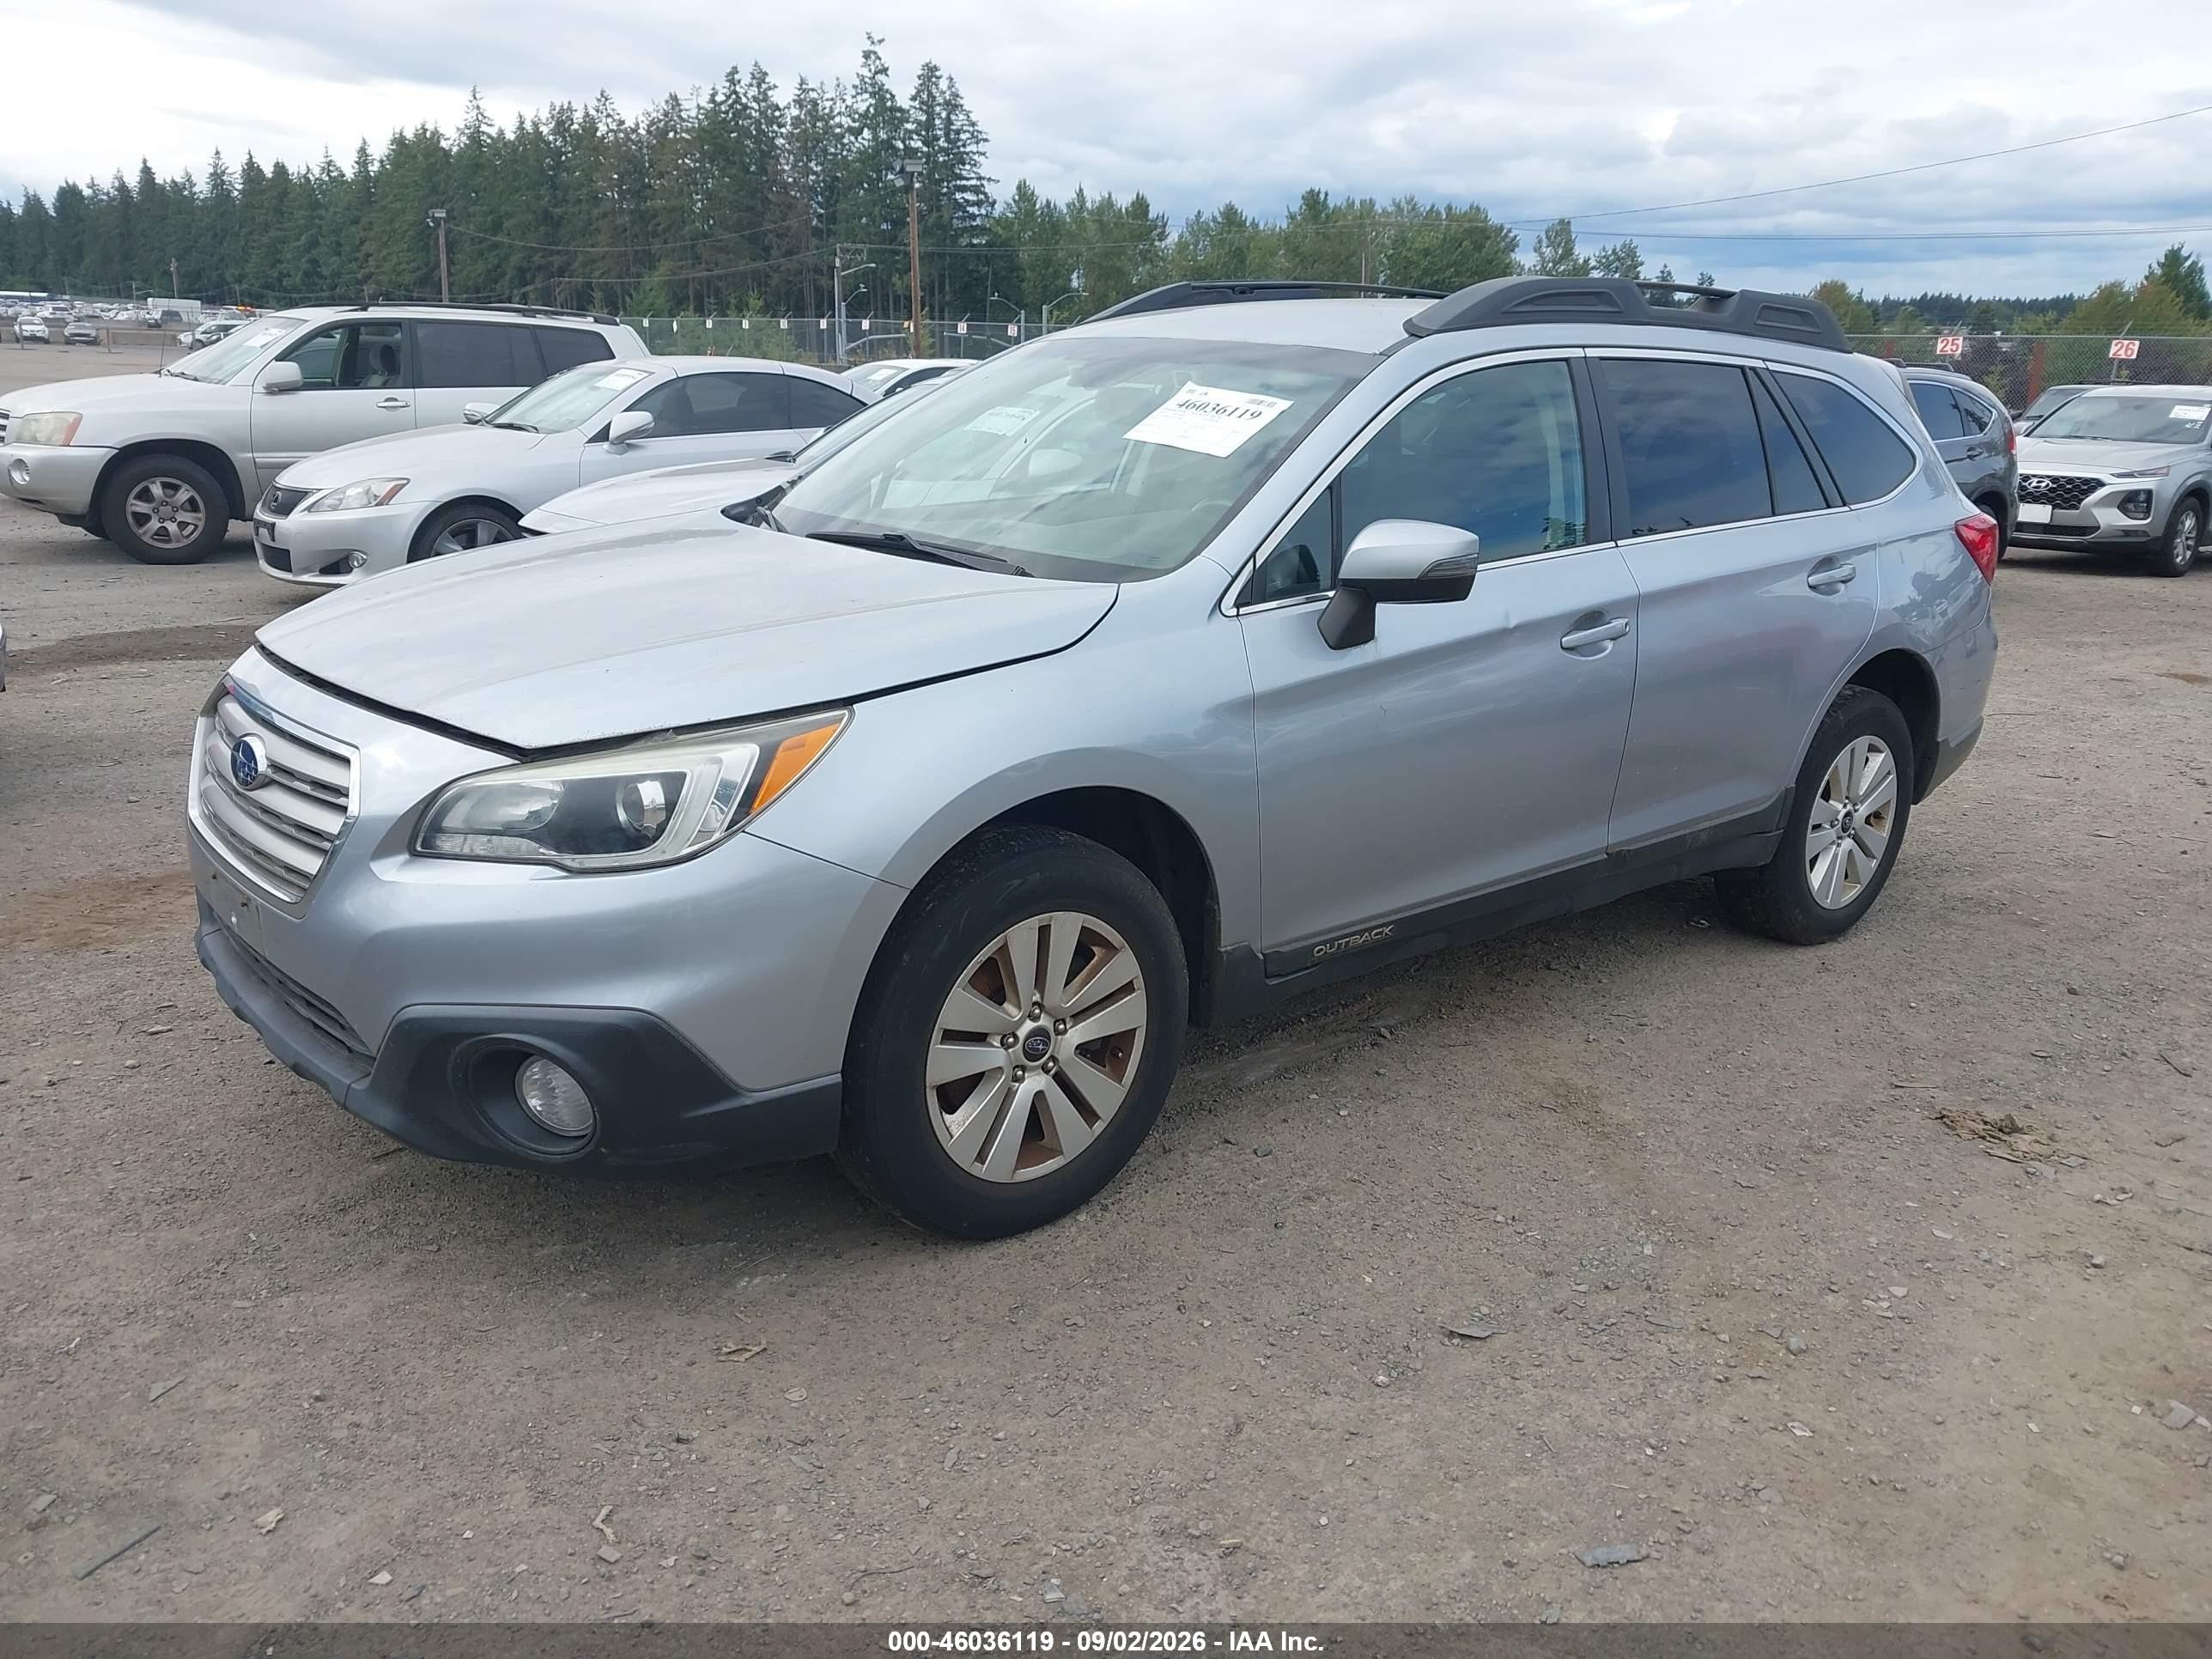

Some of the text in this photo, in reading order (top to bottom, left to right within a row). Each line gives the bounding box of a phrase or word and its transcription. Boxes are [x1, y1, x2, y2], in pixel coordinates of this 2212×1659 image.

[1939, 337, 1960, 354] 25
[2112, 341, 2136, 358] 26
[1176, 398, 1263, 421] 46036119
[1313, 924, 1395, 957] OUTBACK
